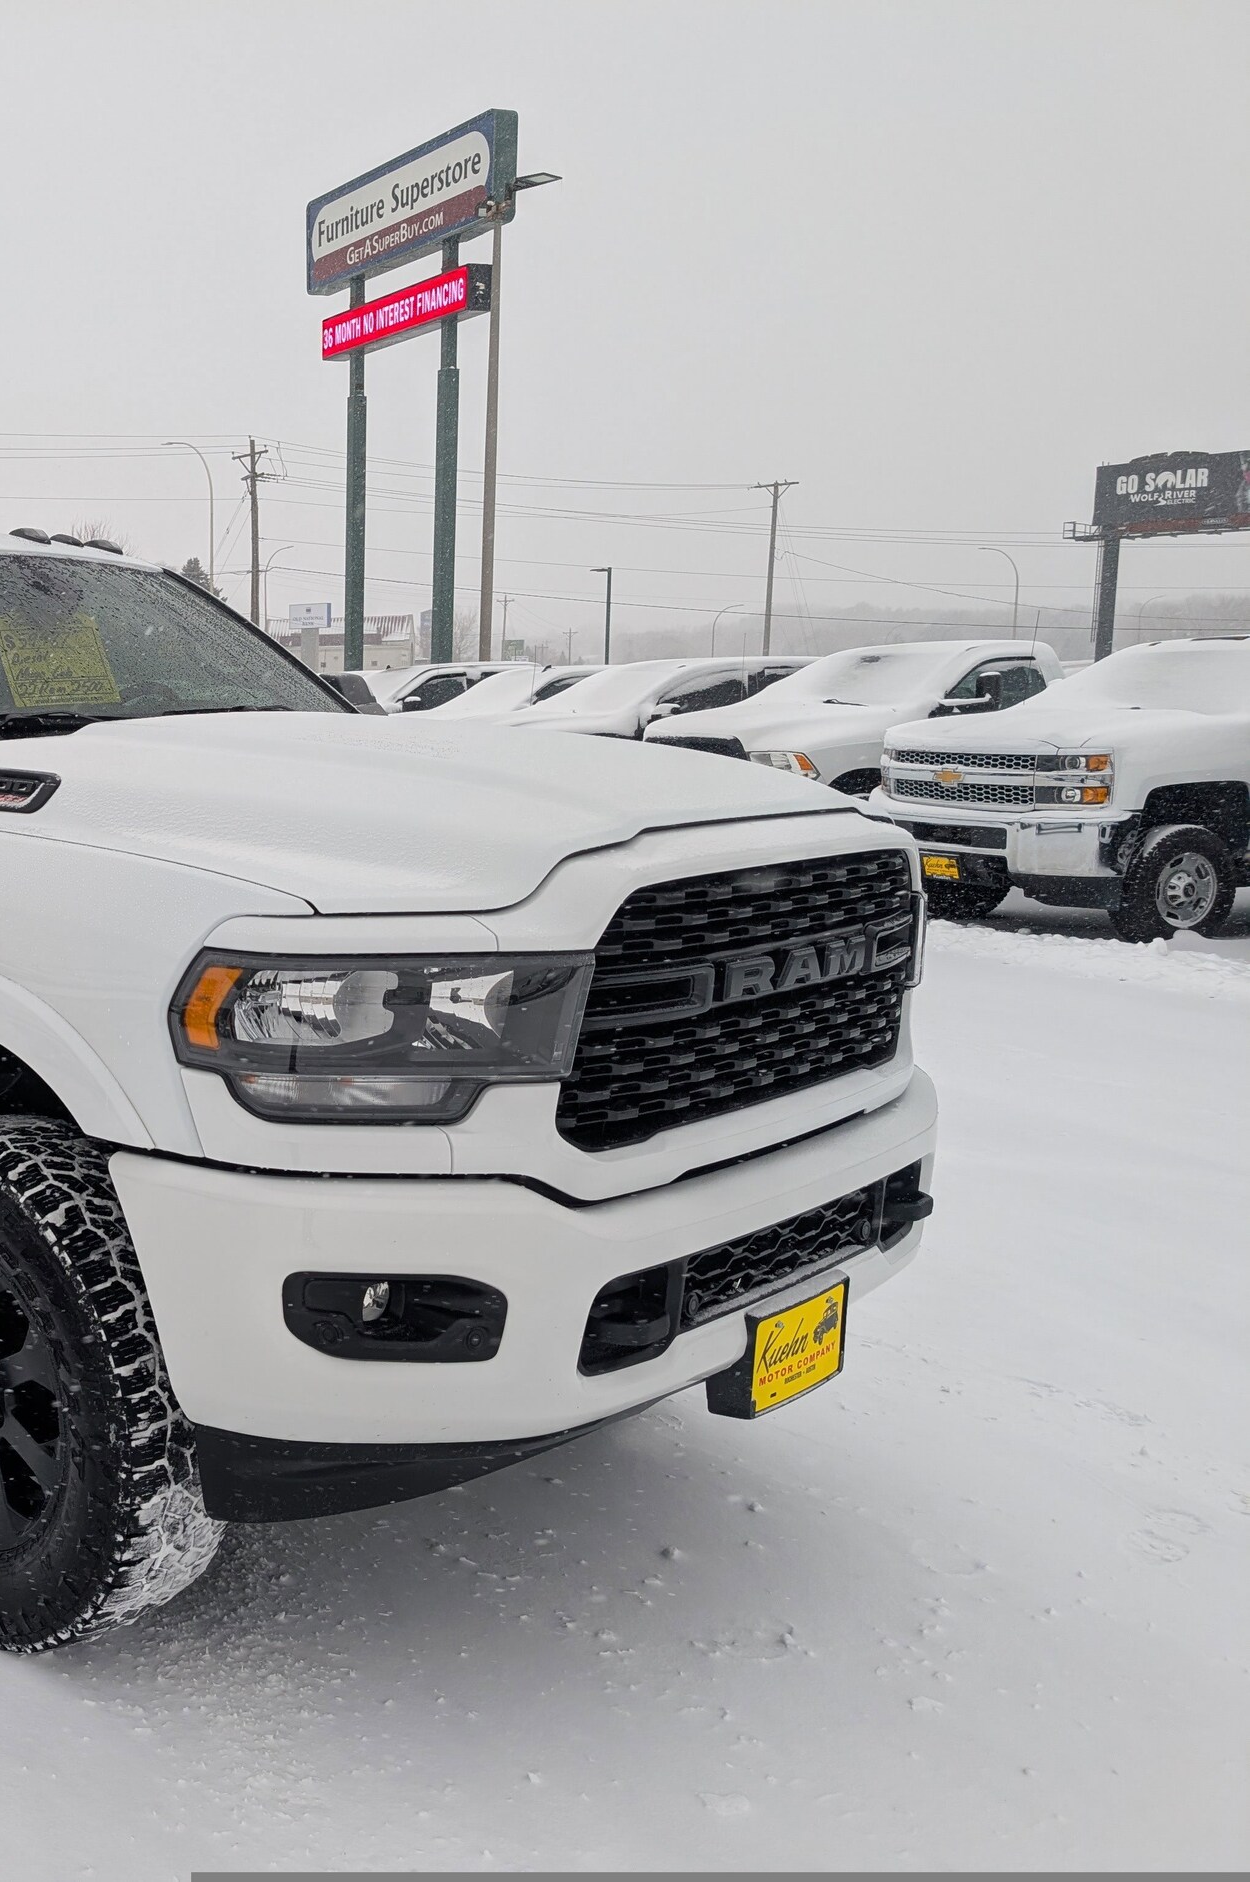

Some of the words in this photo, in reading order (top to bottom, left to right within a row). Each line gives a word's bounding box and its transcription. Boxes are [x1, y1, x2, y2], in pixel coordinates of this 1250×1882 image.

[317, 198, 385, 248] Furniture
[391, 152, 481, 213] Superstore
[323, 327, 333, 350] 36
[334, 316, 361, 346] MONTH
[363, 311, 374, 335] NO
[376, 296, 415, 330] INTEREST
[416, 277, 464, 316] FINANCING
[1116, 475, 1138, 495] GO
[1145, 468, 1209, 492] SOLAR
[1130, 492, 1159, 503] WOLF
[1165, 490, 1197, 499] RIVER
[724, 934, 867, 1001] RAM
[756, 1318, 810, 1374] Kuehn
[758, 1363, 793, 1387] MOTOR
[797, 1341, 836, 1369] COMPANY
